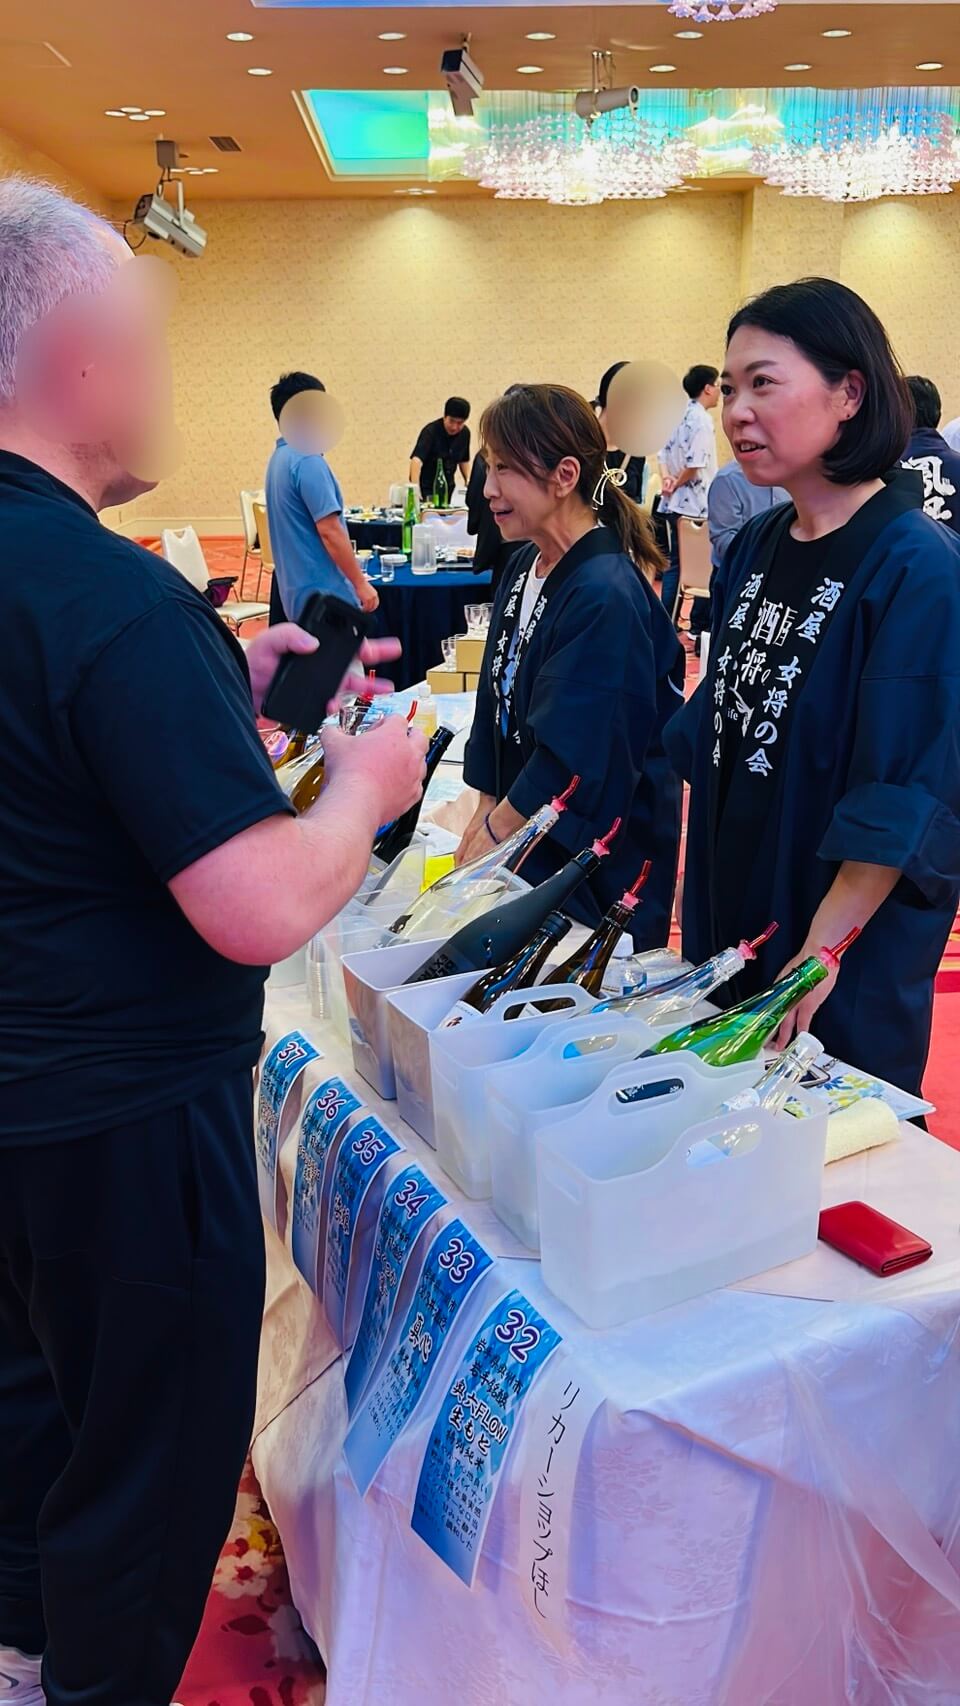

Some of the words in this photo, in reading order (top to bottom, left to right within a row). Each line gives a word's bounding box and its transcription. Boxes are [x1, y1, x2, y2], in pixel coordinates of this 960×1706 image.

[727, 573, 765, 631] 酒屋
[795, 577, 845, 644] 酒屋
[745, 655, 802, 777] 女将の会
[277, 1041, 307, 1068] 37
[316, 1088, 346, 1121] 36
[352, 1130, 386, 1165] 35
[394, 1179, 429, 1219] 34
[438, 1238, 475, 1283] 33
[495, 1309, 540, 1364] 32
[449, 1406, 491, 1456] 生もと
[531, 1381, 580, 1619] リカーショップほし
